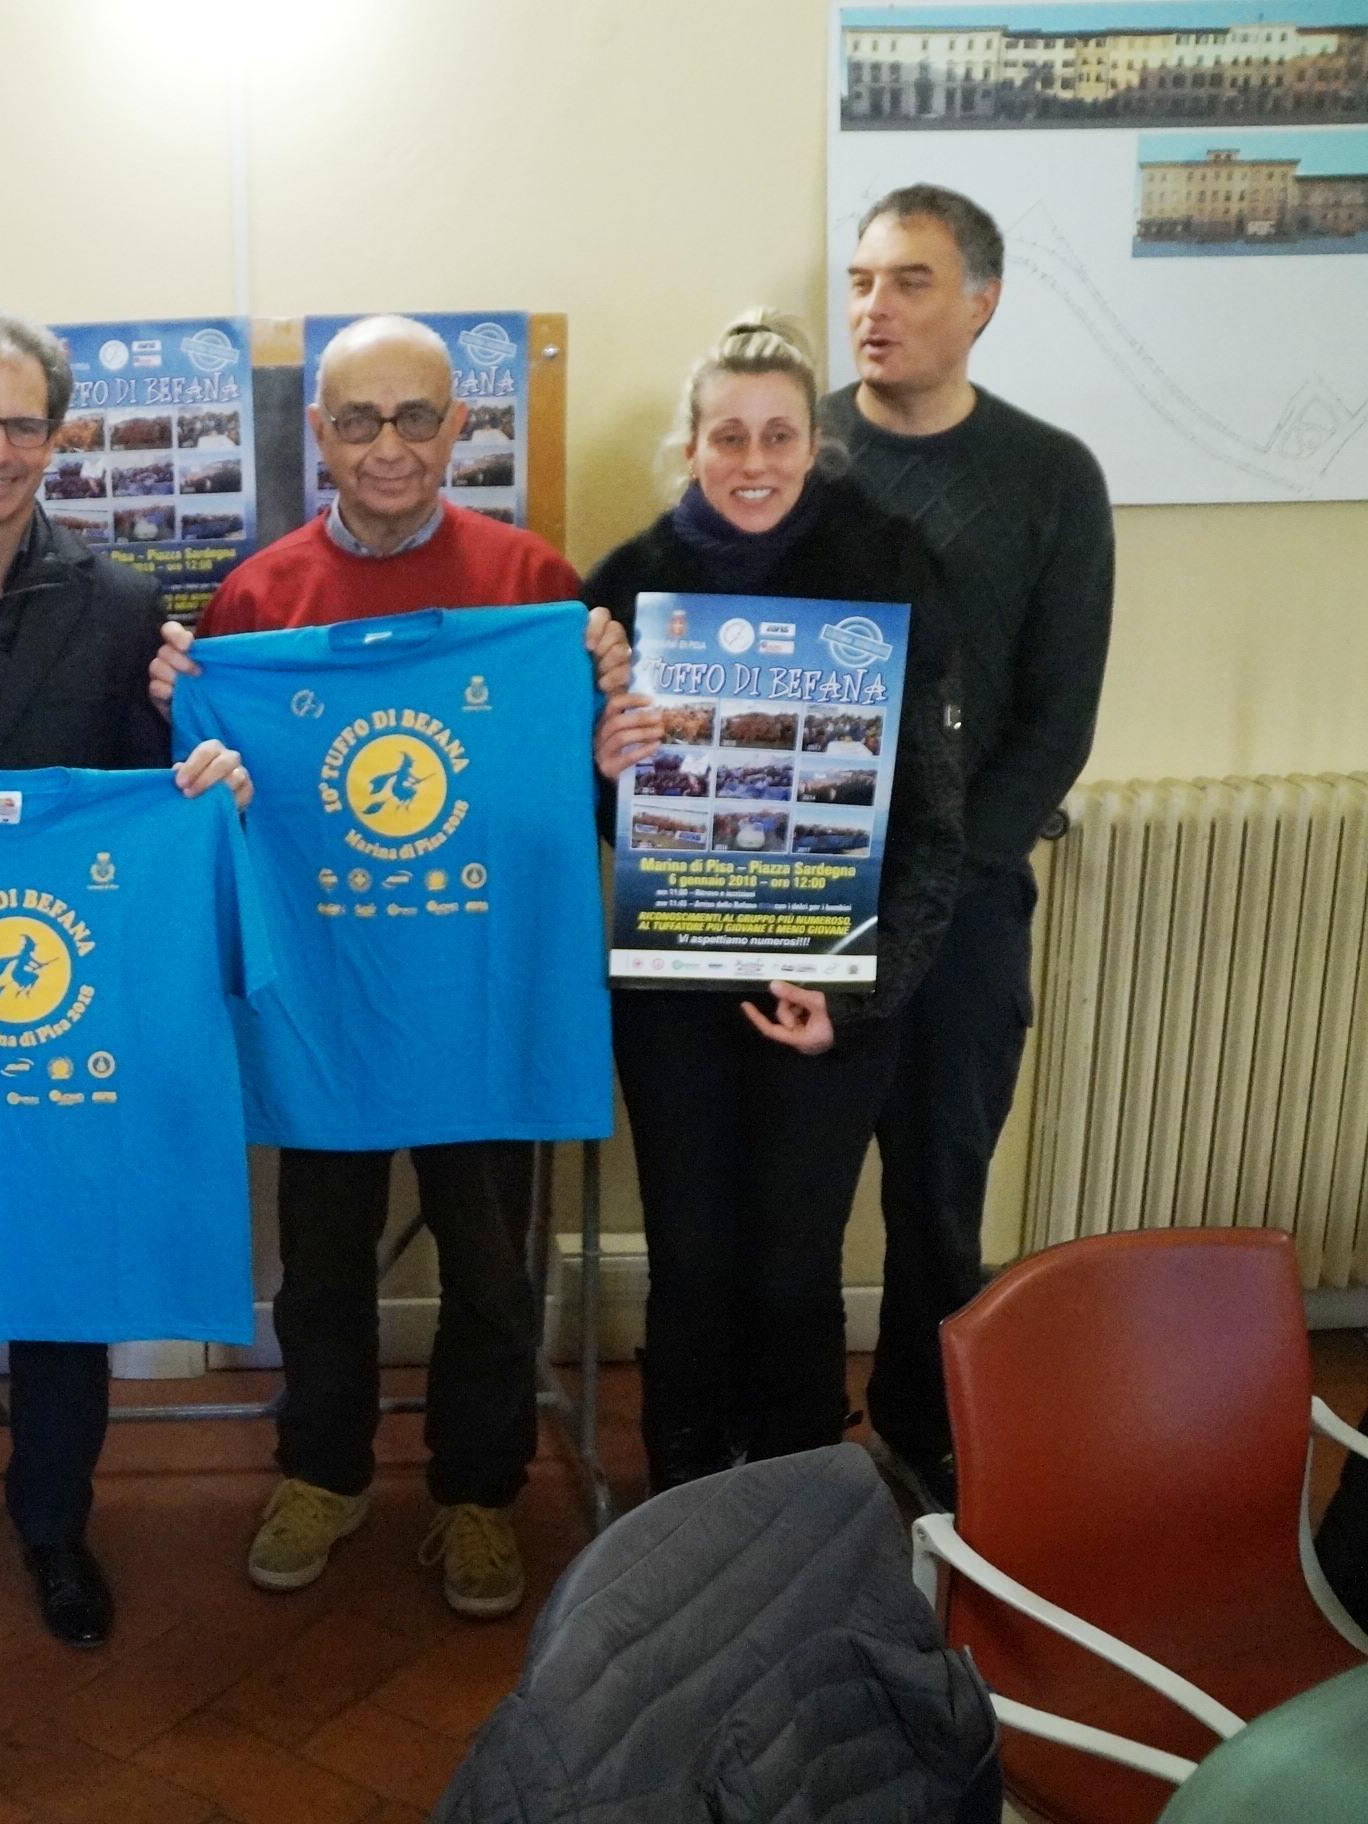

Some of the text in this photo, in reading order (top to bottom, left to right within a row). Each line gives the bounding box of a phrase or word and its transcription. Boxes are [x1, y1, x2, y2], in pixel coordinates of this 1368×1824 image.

[115, 375, 137, 404] DI
[143, 371, 240, 405] BEFANA
[734, 663, 760, 695] DI
[769, 667, 888, 706] BEFANA
[321, 718, 369, 779] TUFFO
[371, 708, 397, 730] DI
[401, 708, 470, 774] BEFANA
[345, 800, 470, 860] Marina di Pisa 2018
[641, 858, 687, 872] Marina
[690, 858, 703, 872] di
[706, 859, 734, 873] Pisa
[749, 860, 790, 875] Piazza
[794, 861, 856, 879] Sardegna
[669, 873, 677, 885] 6
[679, 874, 725, 887] gennaio
[728, 875, 757, 887] 2018
[770, 878, 790, 888] ore
[794, 877, 826, 889] 12:00
[23, 889, 96, 957] BEFANA
[637, 921, 650, 930] AL
[653, 921, 706, 931] TUFFATORE
[724, 923, 766, 934] GIOVANE
[768, 925, 774, 933] E
[776, 924, 805, 934] MENO
[807, 925, 850, 935] GIOVANE
[723, 914, 735, 923] AL
[736, 914, 776, 923] GRUPPO
[679, 934, 811, 946] Vi aspettiamo numerosi!!!
[19, 1031, 37, 1047] di
[35, 1019, 72, 1043] Pisa
[67, 984, 95, 1022] 2018
